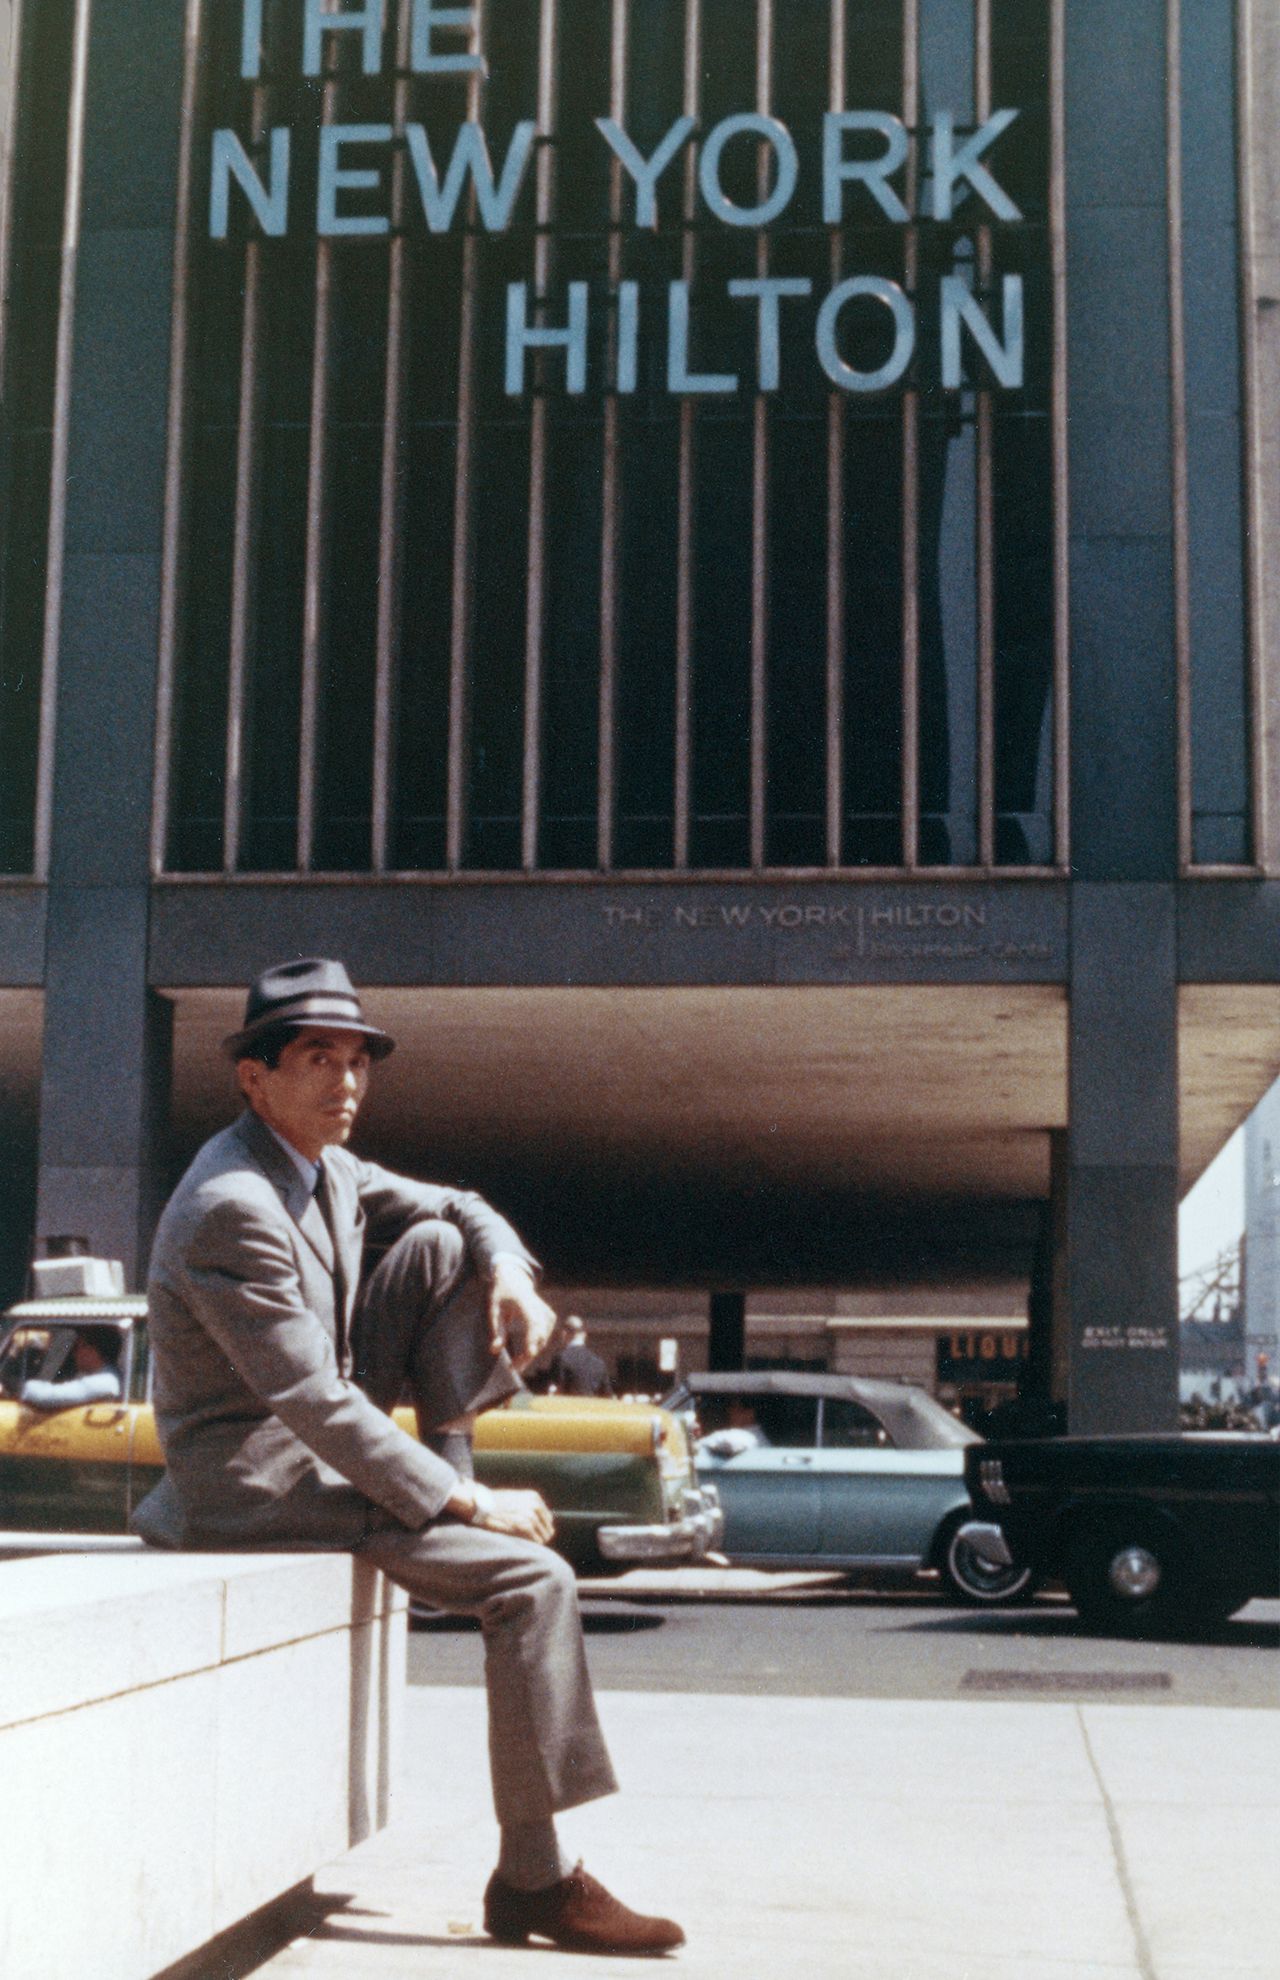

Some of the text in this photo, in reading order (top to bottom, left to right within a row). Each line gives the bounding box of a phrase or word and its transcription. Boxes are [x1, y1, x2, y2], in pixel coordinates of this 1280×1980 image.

[210, 109, 1023, 239] NEW YORK
[505, 275, 1023, 396] HILTON
[759, 905, 849, 926] YORK
[871, 905, 986, 926] HILTON
